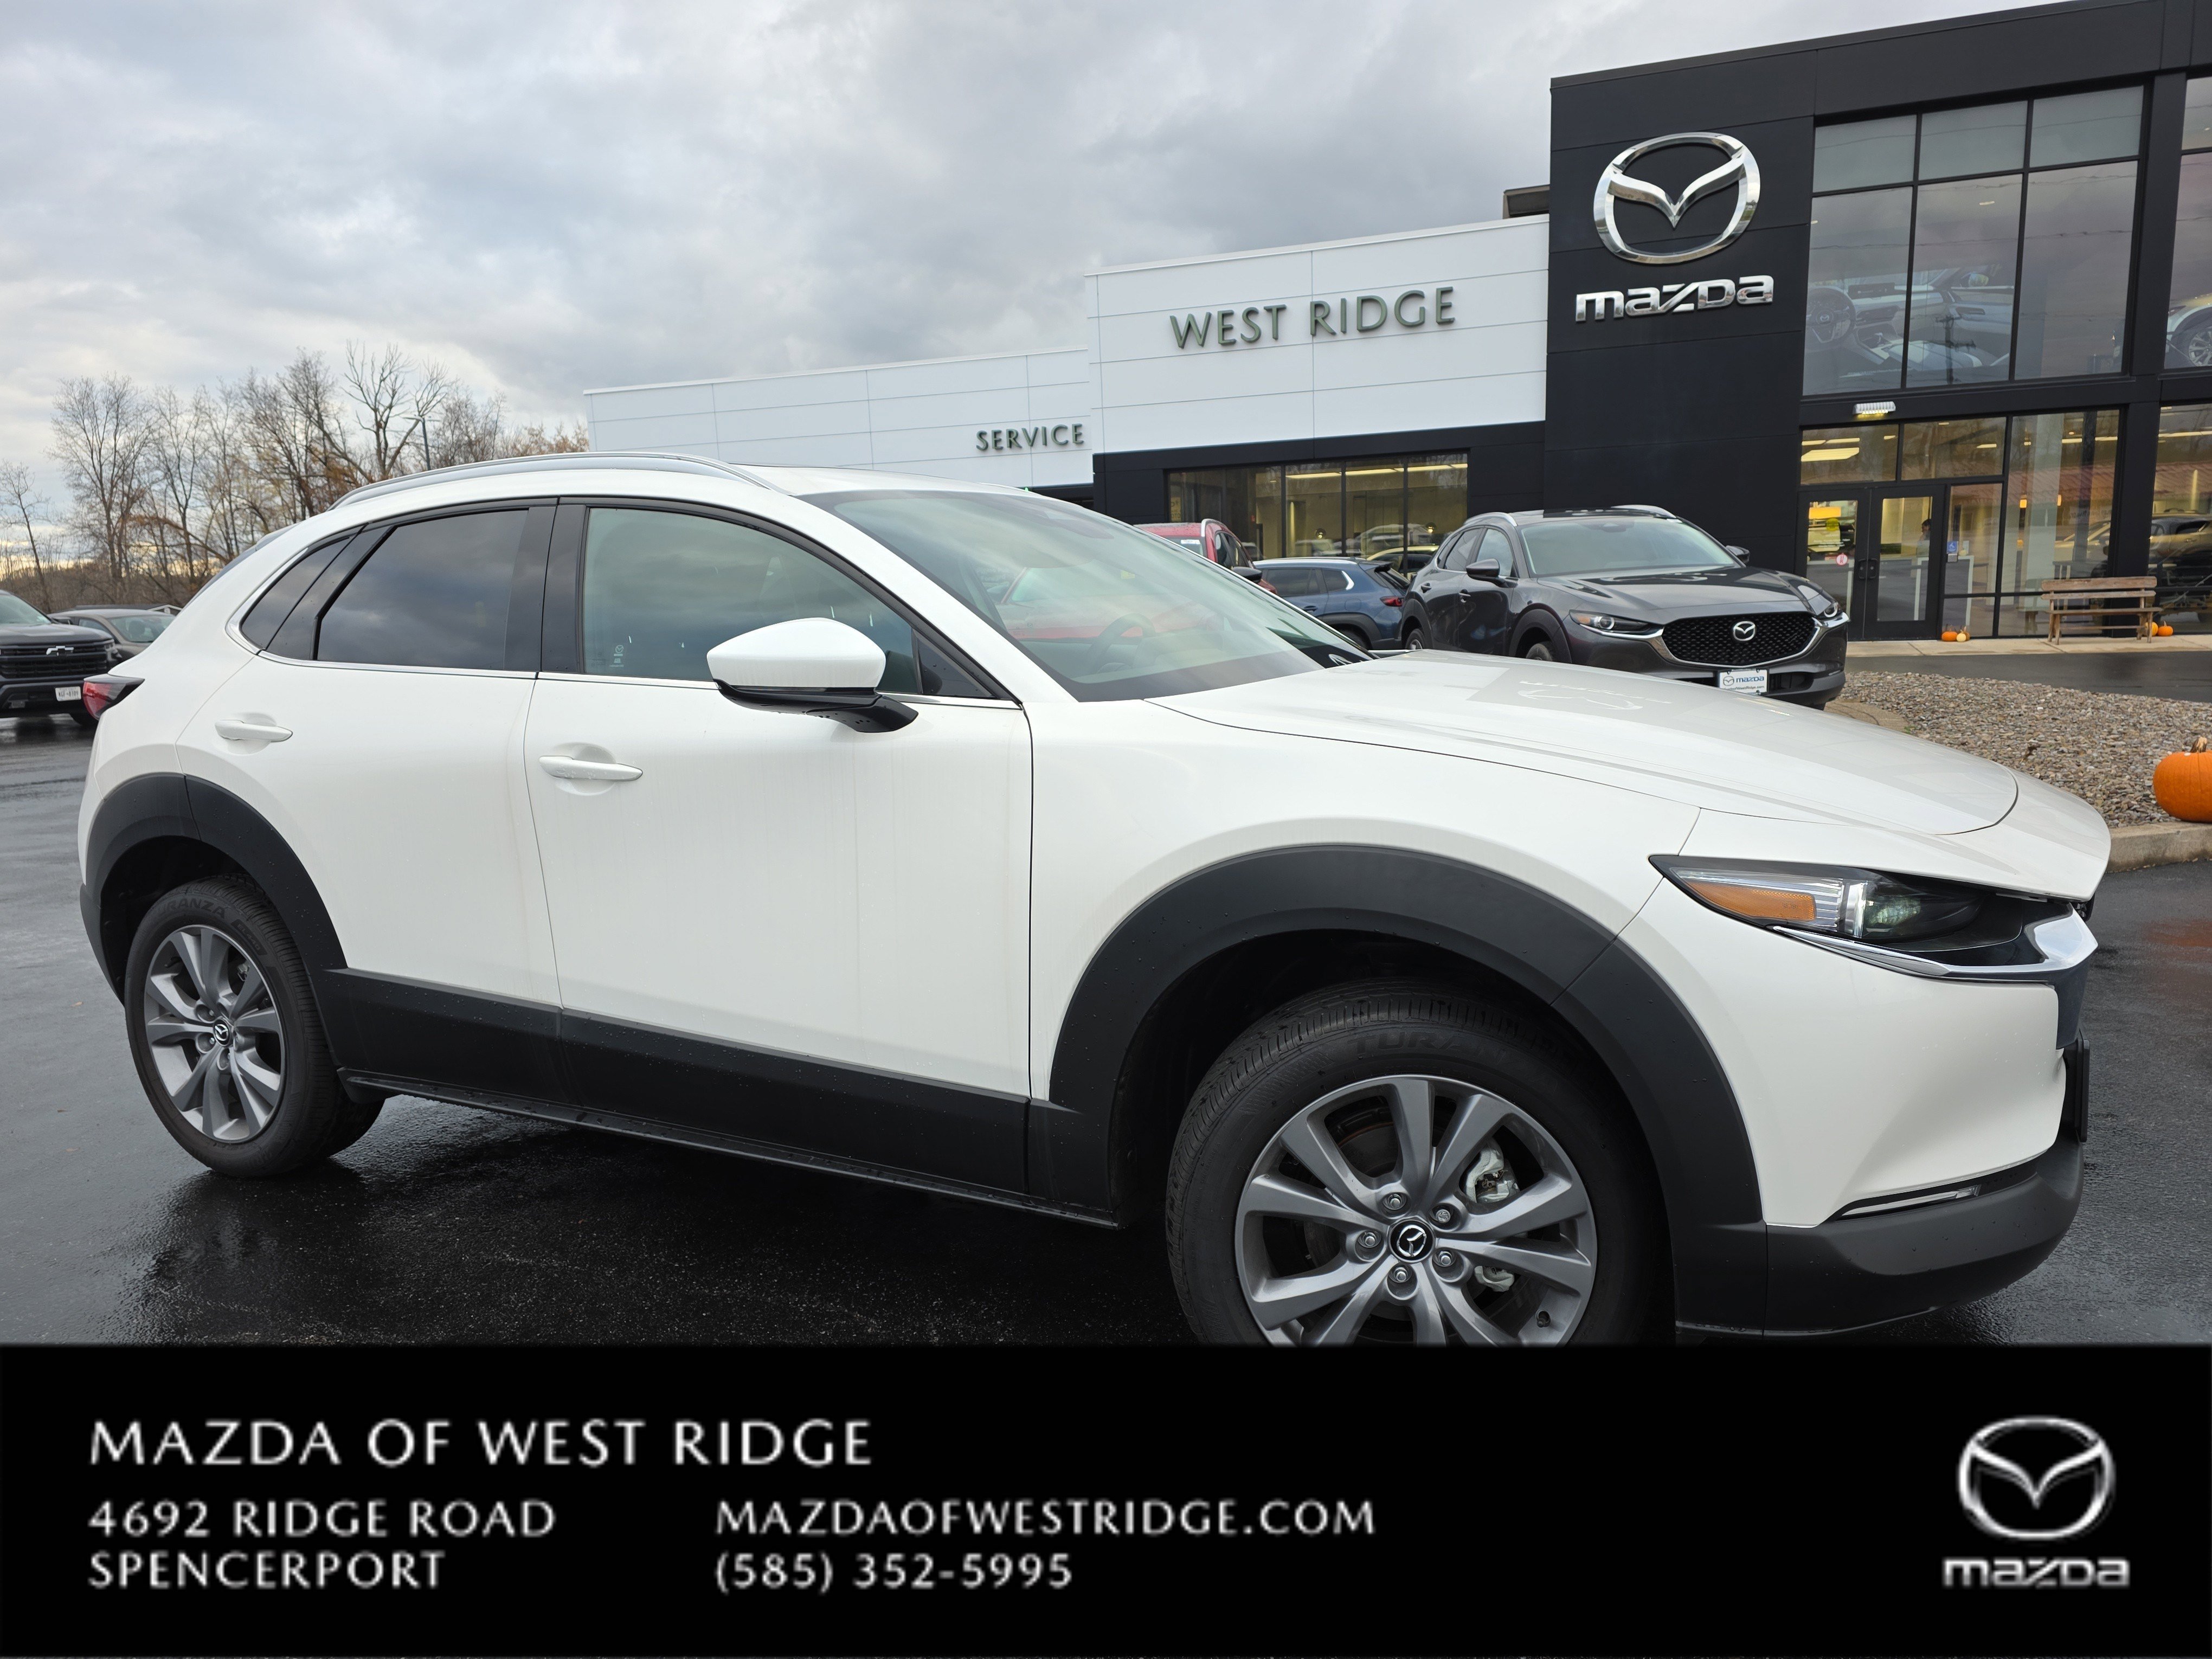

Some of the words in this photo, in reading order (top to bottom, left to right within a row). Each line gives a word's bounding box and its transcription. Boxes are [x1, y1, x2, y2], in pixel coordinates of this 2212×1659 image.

[1169, 304, 1287, 349] WEST
[1309, 286, 1456, 337] RIDGE
[1576, 275, 1774, 322] mazda
[976, 423, 1084, 452] SERVICE
